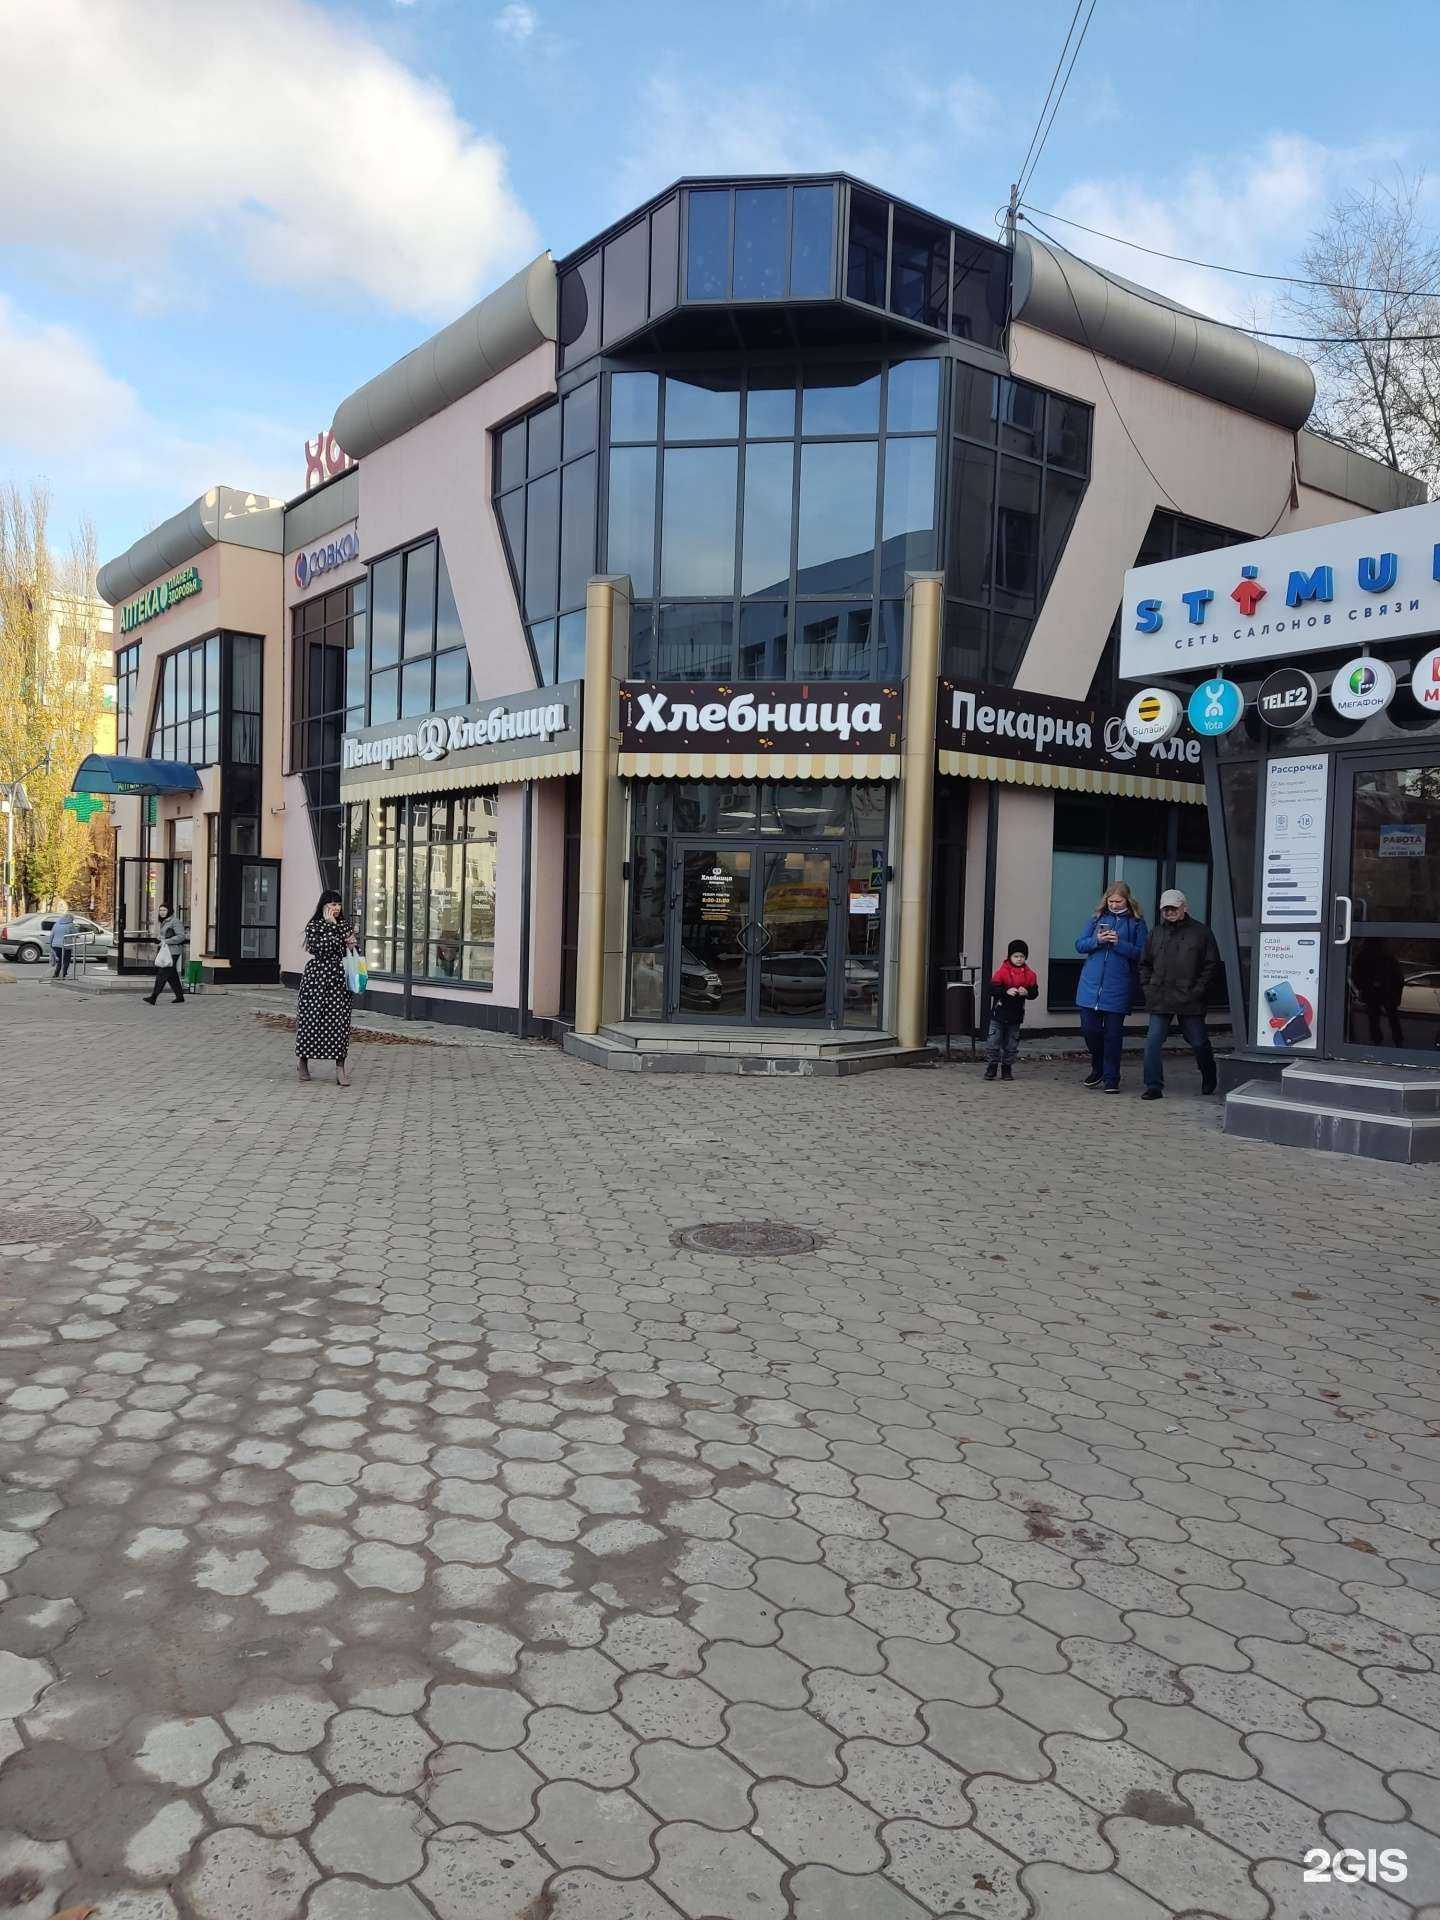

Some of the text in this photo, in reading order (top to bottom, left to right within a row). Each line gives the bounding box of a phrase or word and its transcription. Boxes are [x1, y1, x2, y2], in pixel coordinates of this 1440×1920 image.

[120, 586, 160, 631] АПТЕКА
[1174, 599, 1420, 650] СЕТЬ САЛОНОВ СВЯЗИ
[1262, 687, 1308, 711] TELE2
[1337, 697, 1385, 711] МЕГАФОН
[635, 693, 883, 741] Хлебница
[952, 690, 1093, 752] Пекарня
[1133, 724, 1165, 736] Билайн
[1204, 720, 1223, 730] Yota
[344, 704, 566, 770] Пекарня Хлебница
[1271, 764, 1323, 774] Рассрочка
